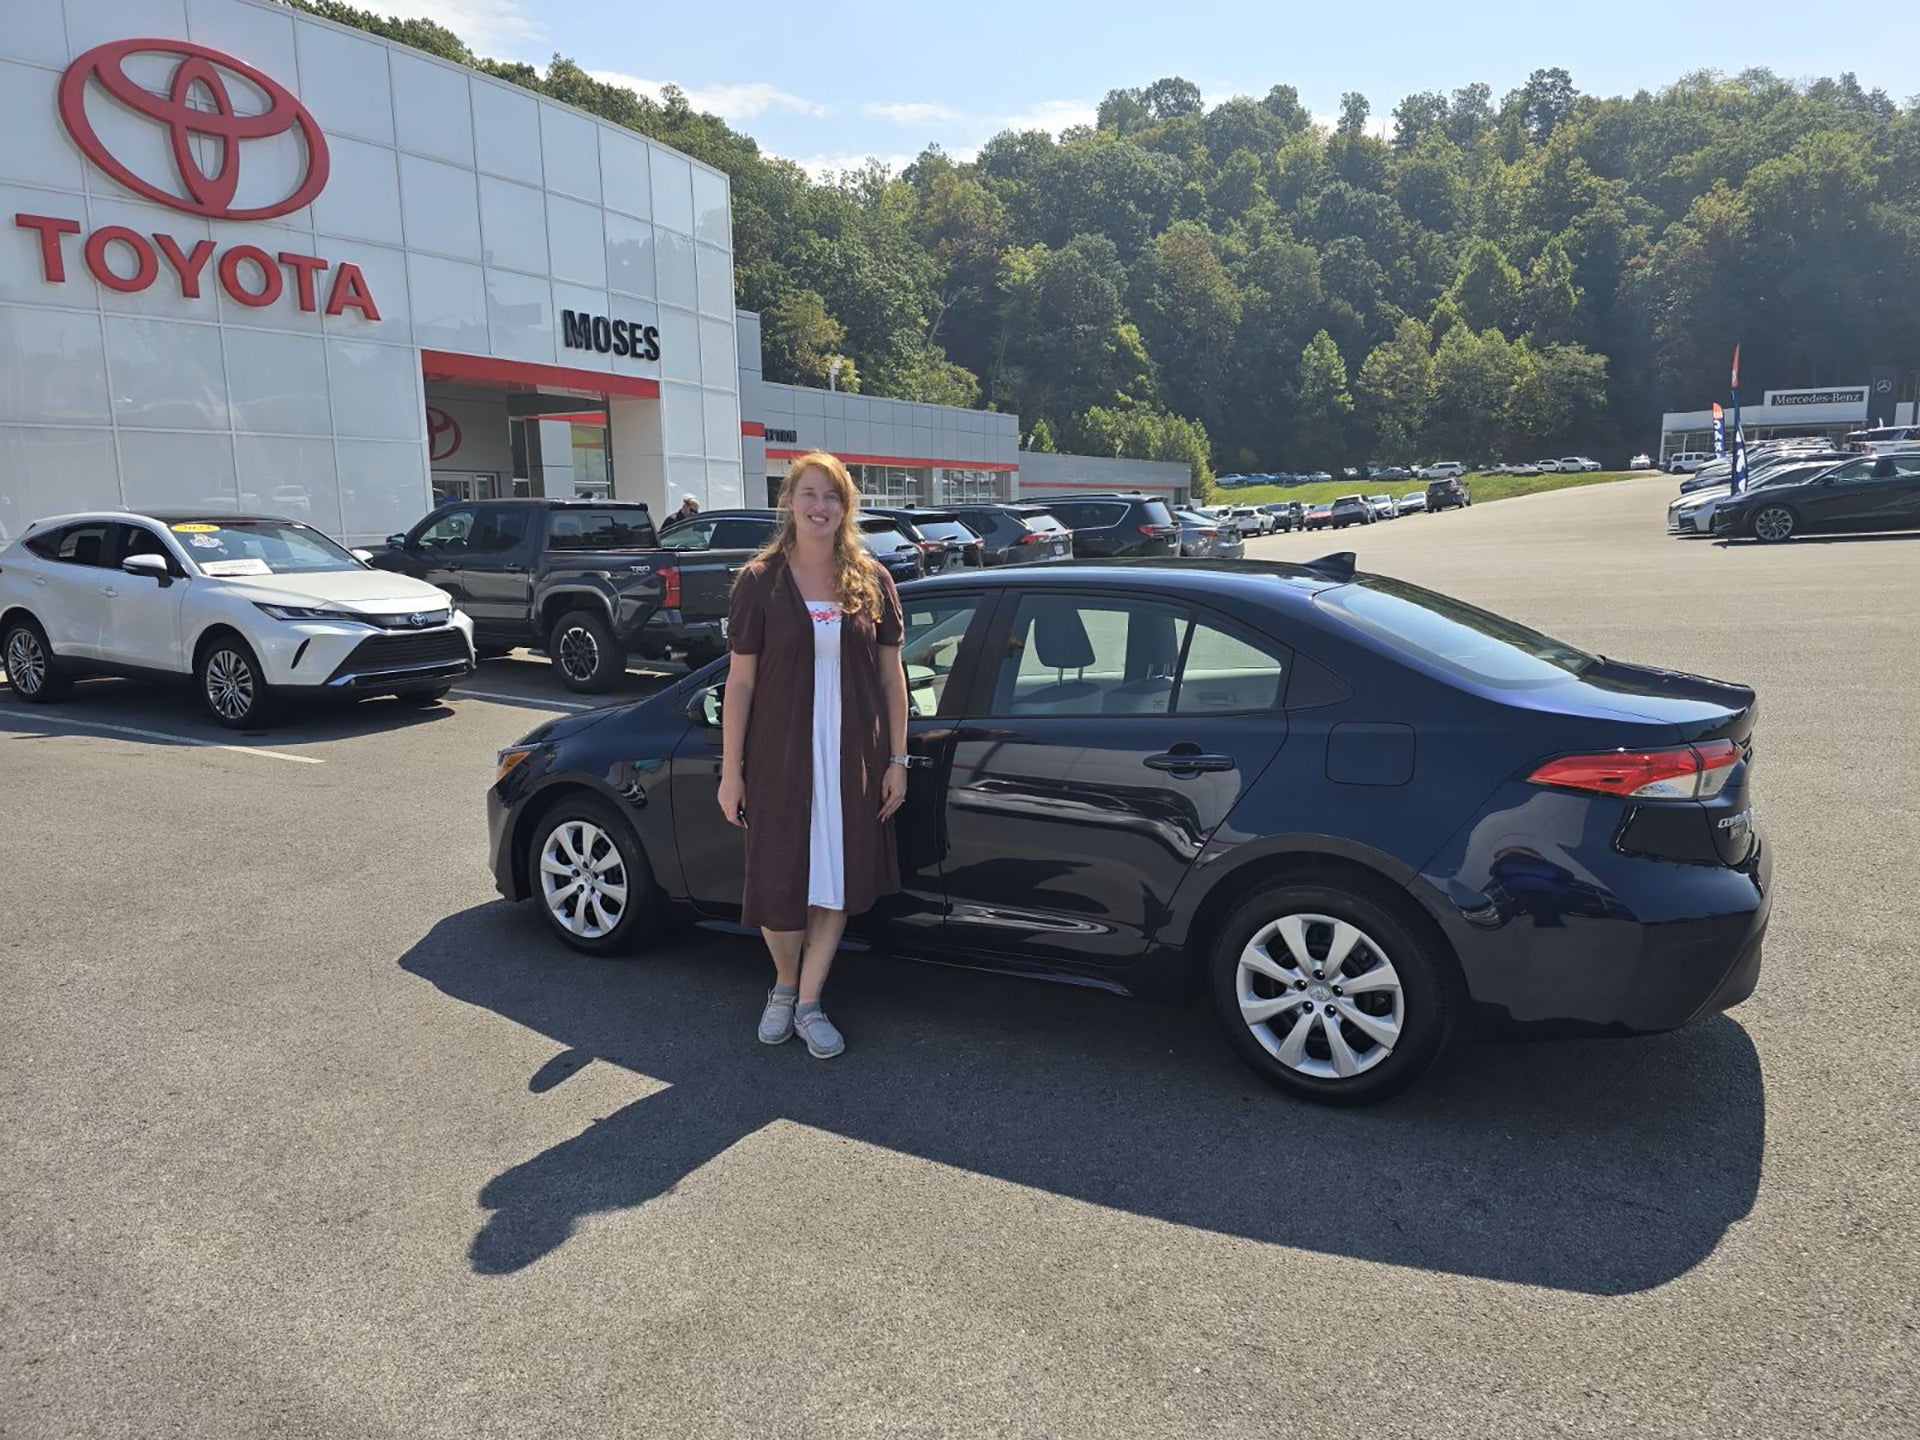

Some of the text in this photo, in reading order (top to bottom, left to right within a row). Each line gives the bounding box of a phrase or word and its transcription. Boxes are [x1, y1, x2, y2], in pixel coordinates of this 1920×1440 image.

[15, 213, 382, 321] TOYOTA
[563, 309, 660, 361] MOSES
[1775, 393, 1860, 406] Mercedes-Benz
